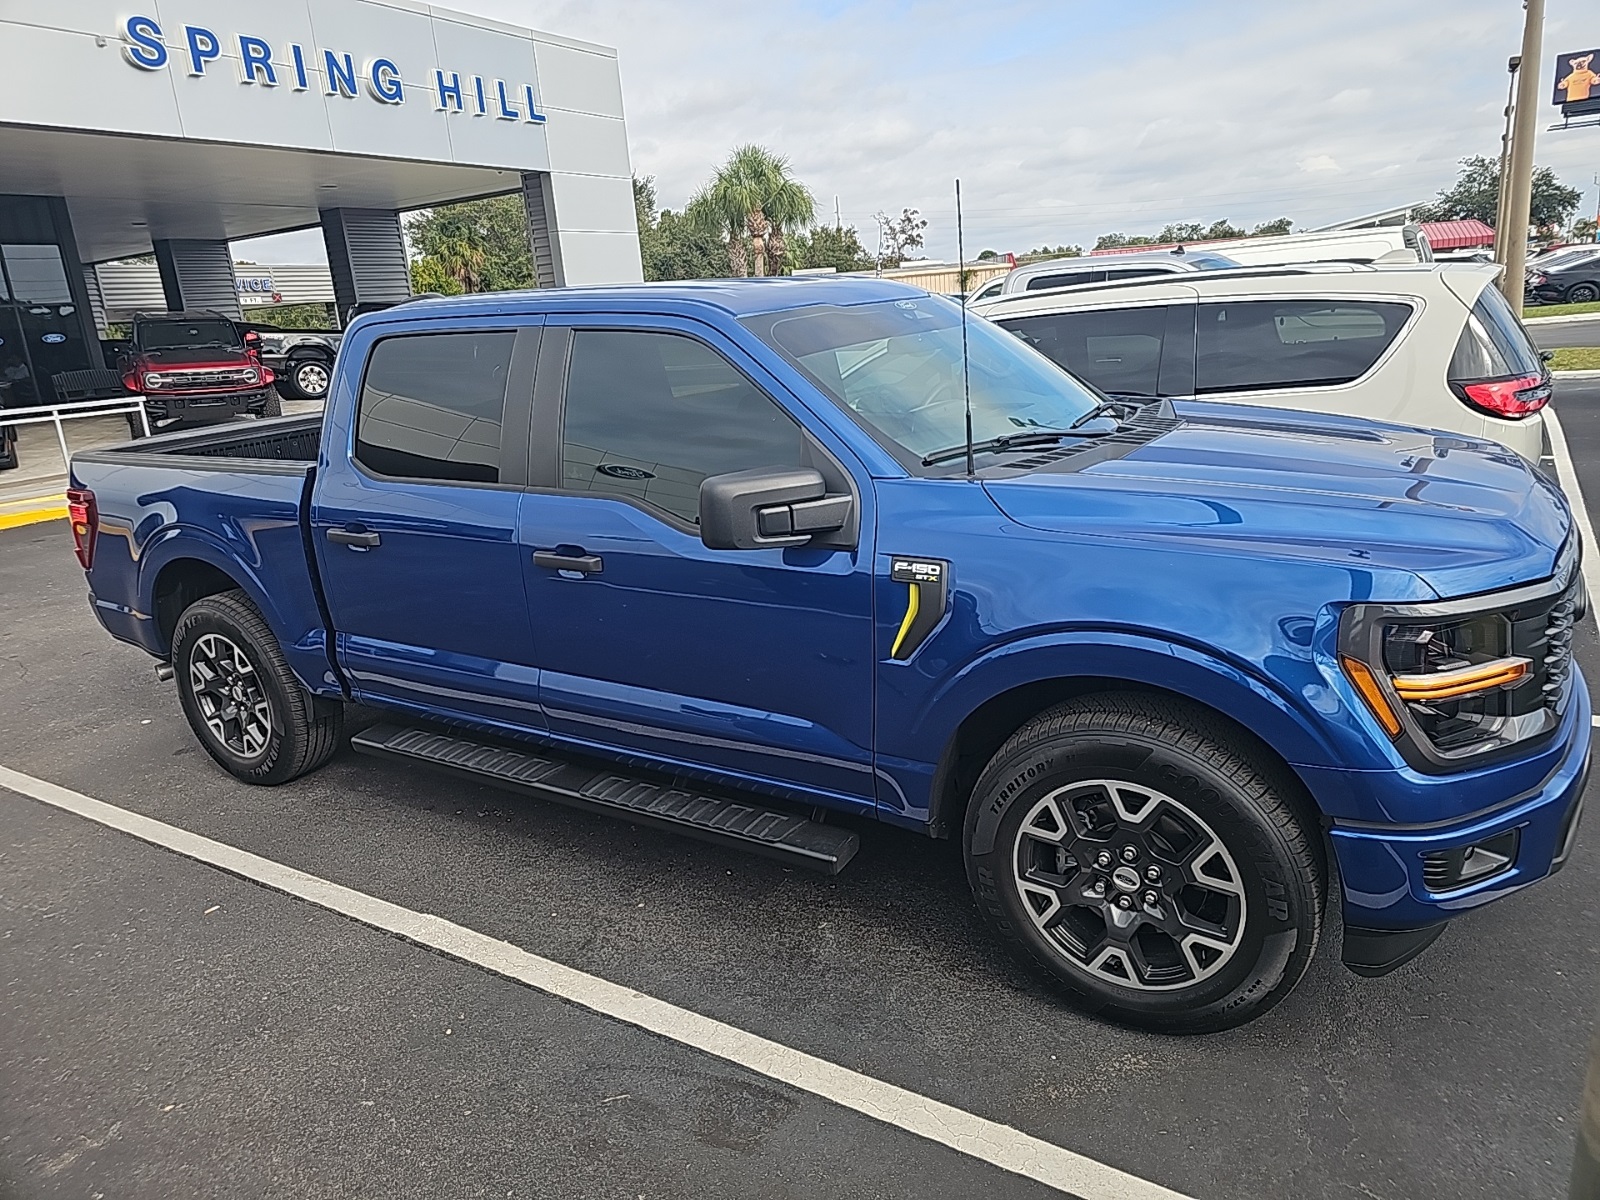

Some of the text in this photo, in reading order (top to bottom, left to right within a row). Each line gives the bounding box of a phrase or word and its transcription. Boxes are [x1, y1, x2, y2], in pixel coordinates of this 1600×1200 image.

[122, 14, 547, 124] SPRING HILL
[894, 561, 940, 575] F-150
[989, 758, 1054, 815] TERRITORY
